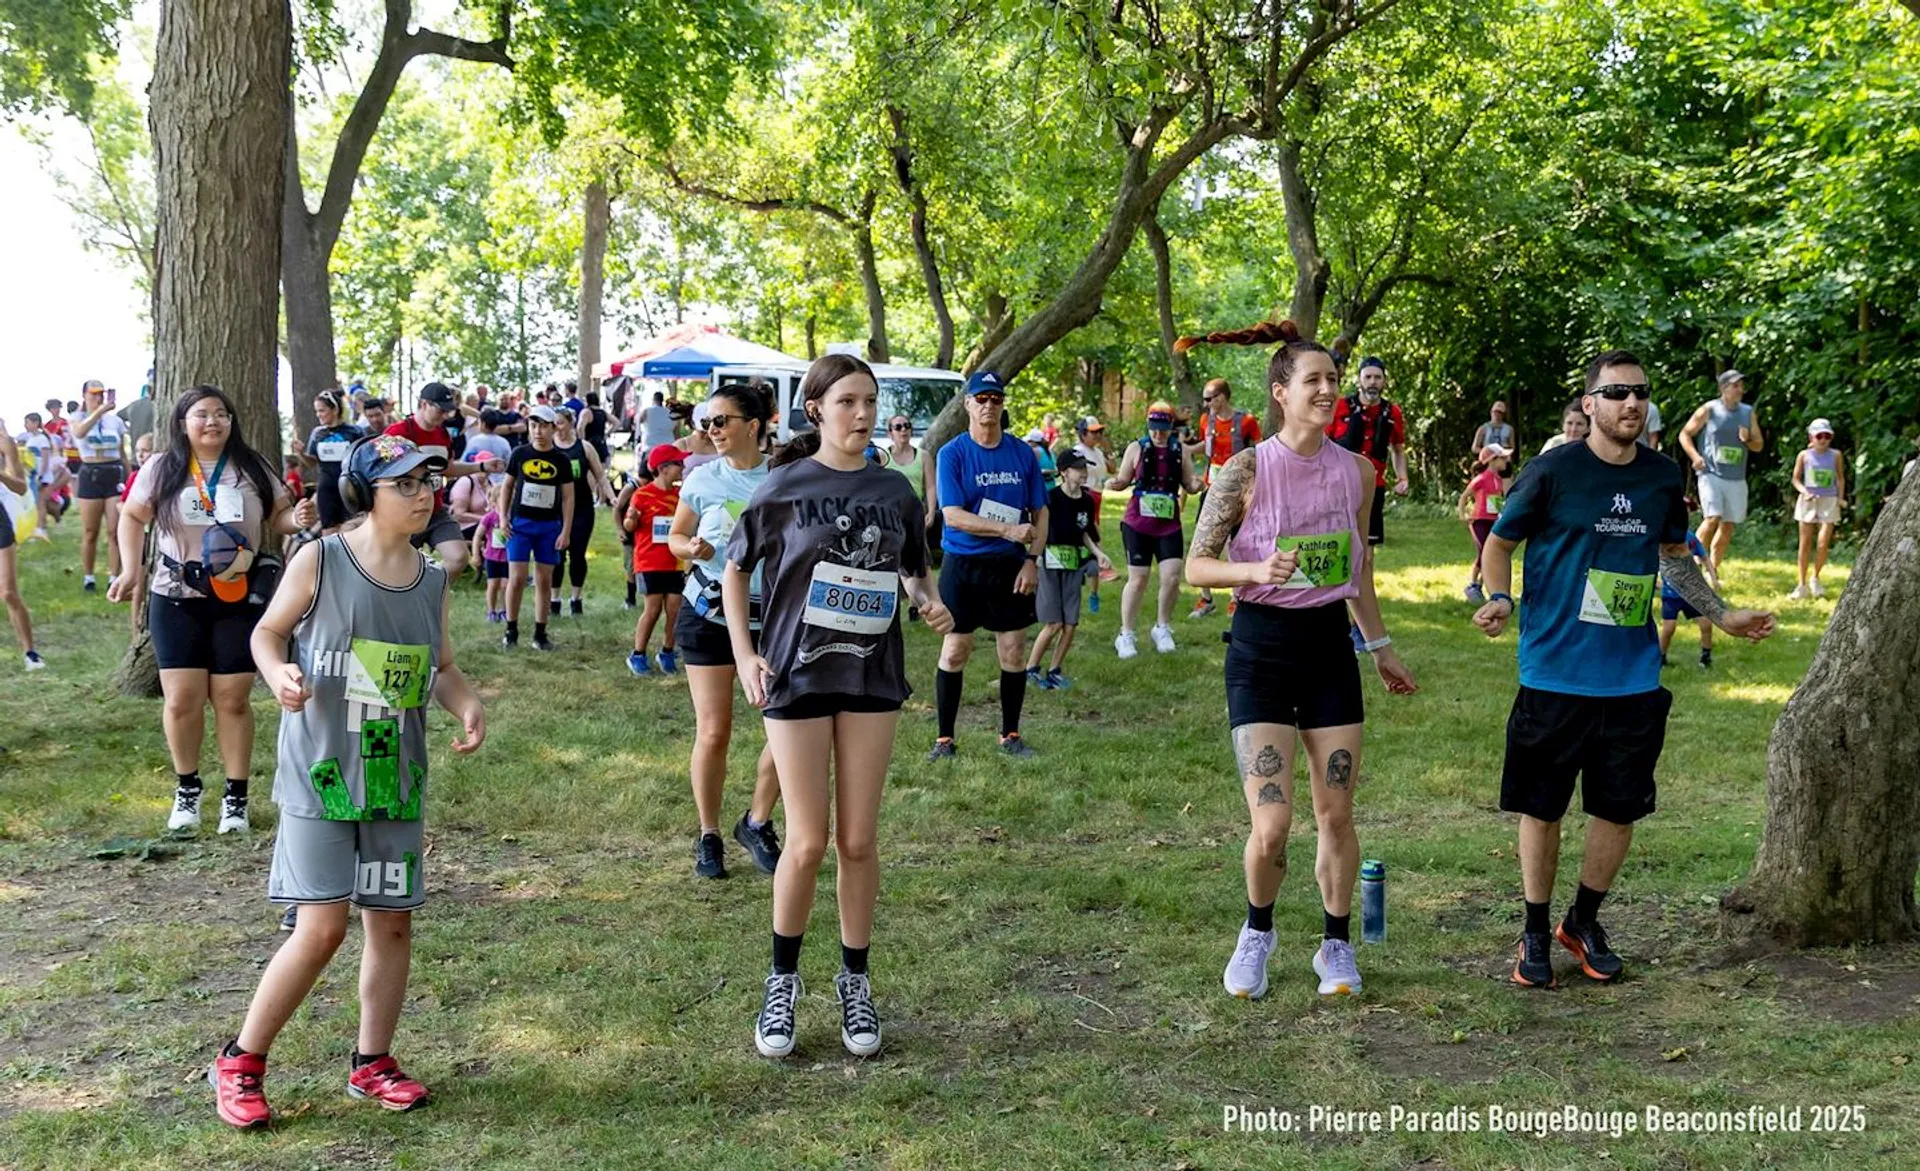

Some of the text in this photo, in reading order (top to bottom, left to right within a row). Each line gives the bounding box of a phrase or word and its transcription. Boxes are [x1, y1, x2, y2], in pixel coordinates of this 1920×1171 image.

[795, 497, 850, 530] JACK
[1594, 523, 1647, 534] TOURMENTE
[1298, 540, 1339, 552] Kathleen
[1306, 555, 1329, 573] 126
[826, 587, 883, 614] 8064
[1613, 594, 1635, 612] 142
[386, 650, 411, 664] Liam
[384, 668, 410, 688] 127
[358, 861, 408, 896] 09
